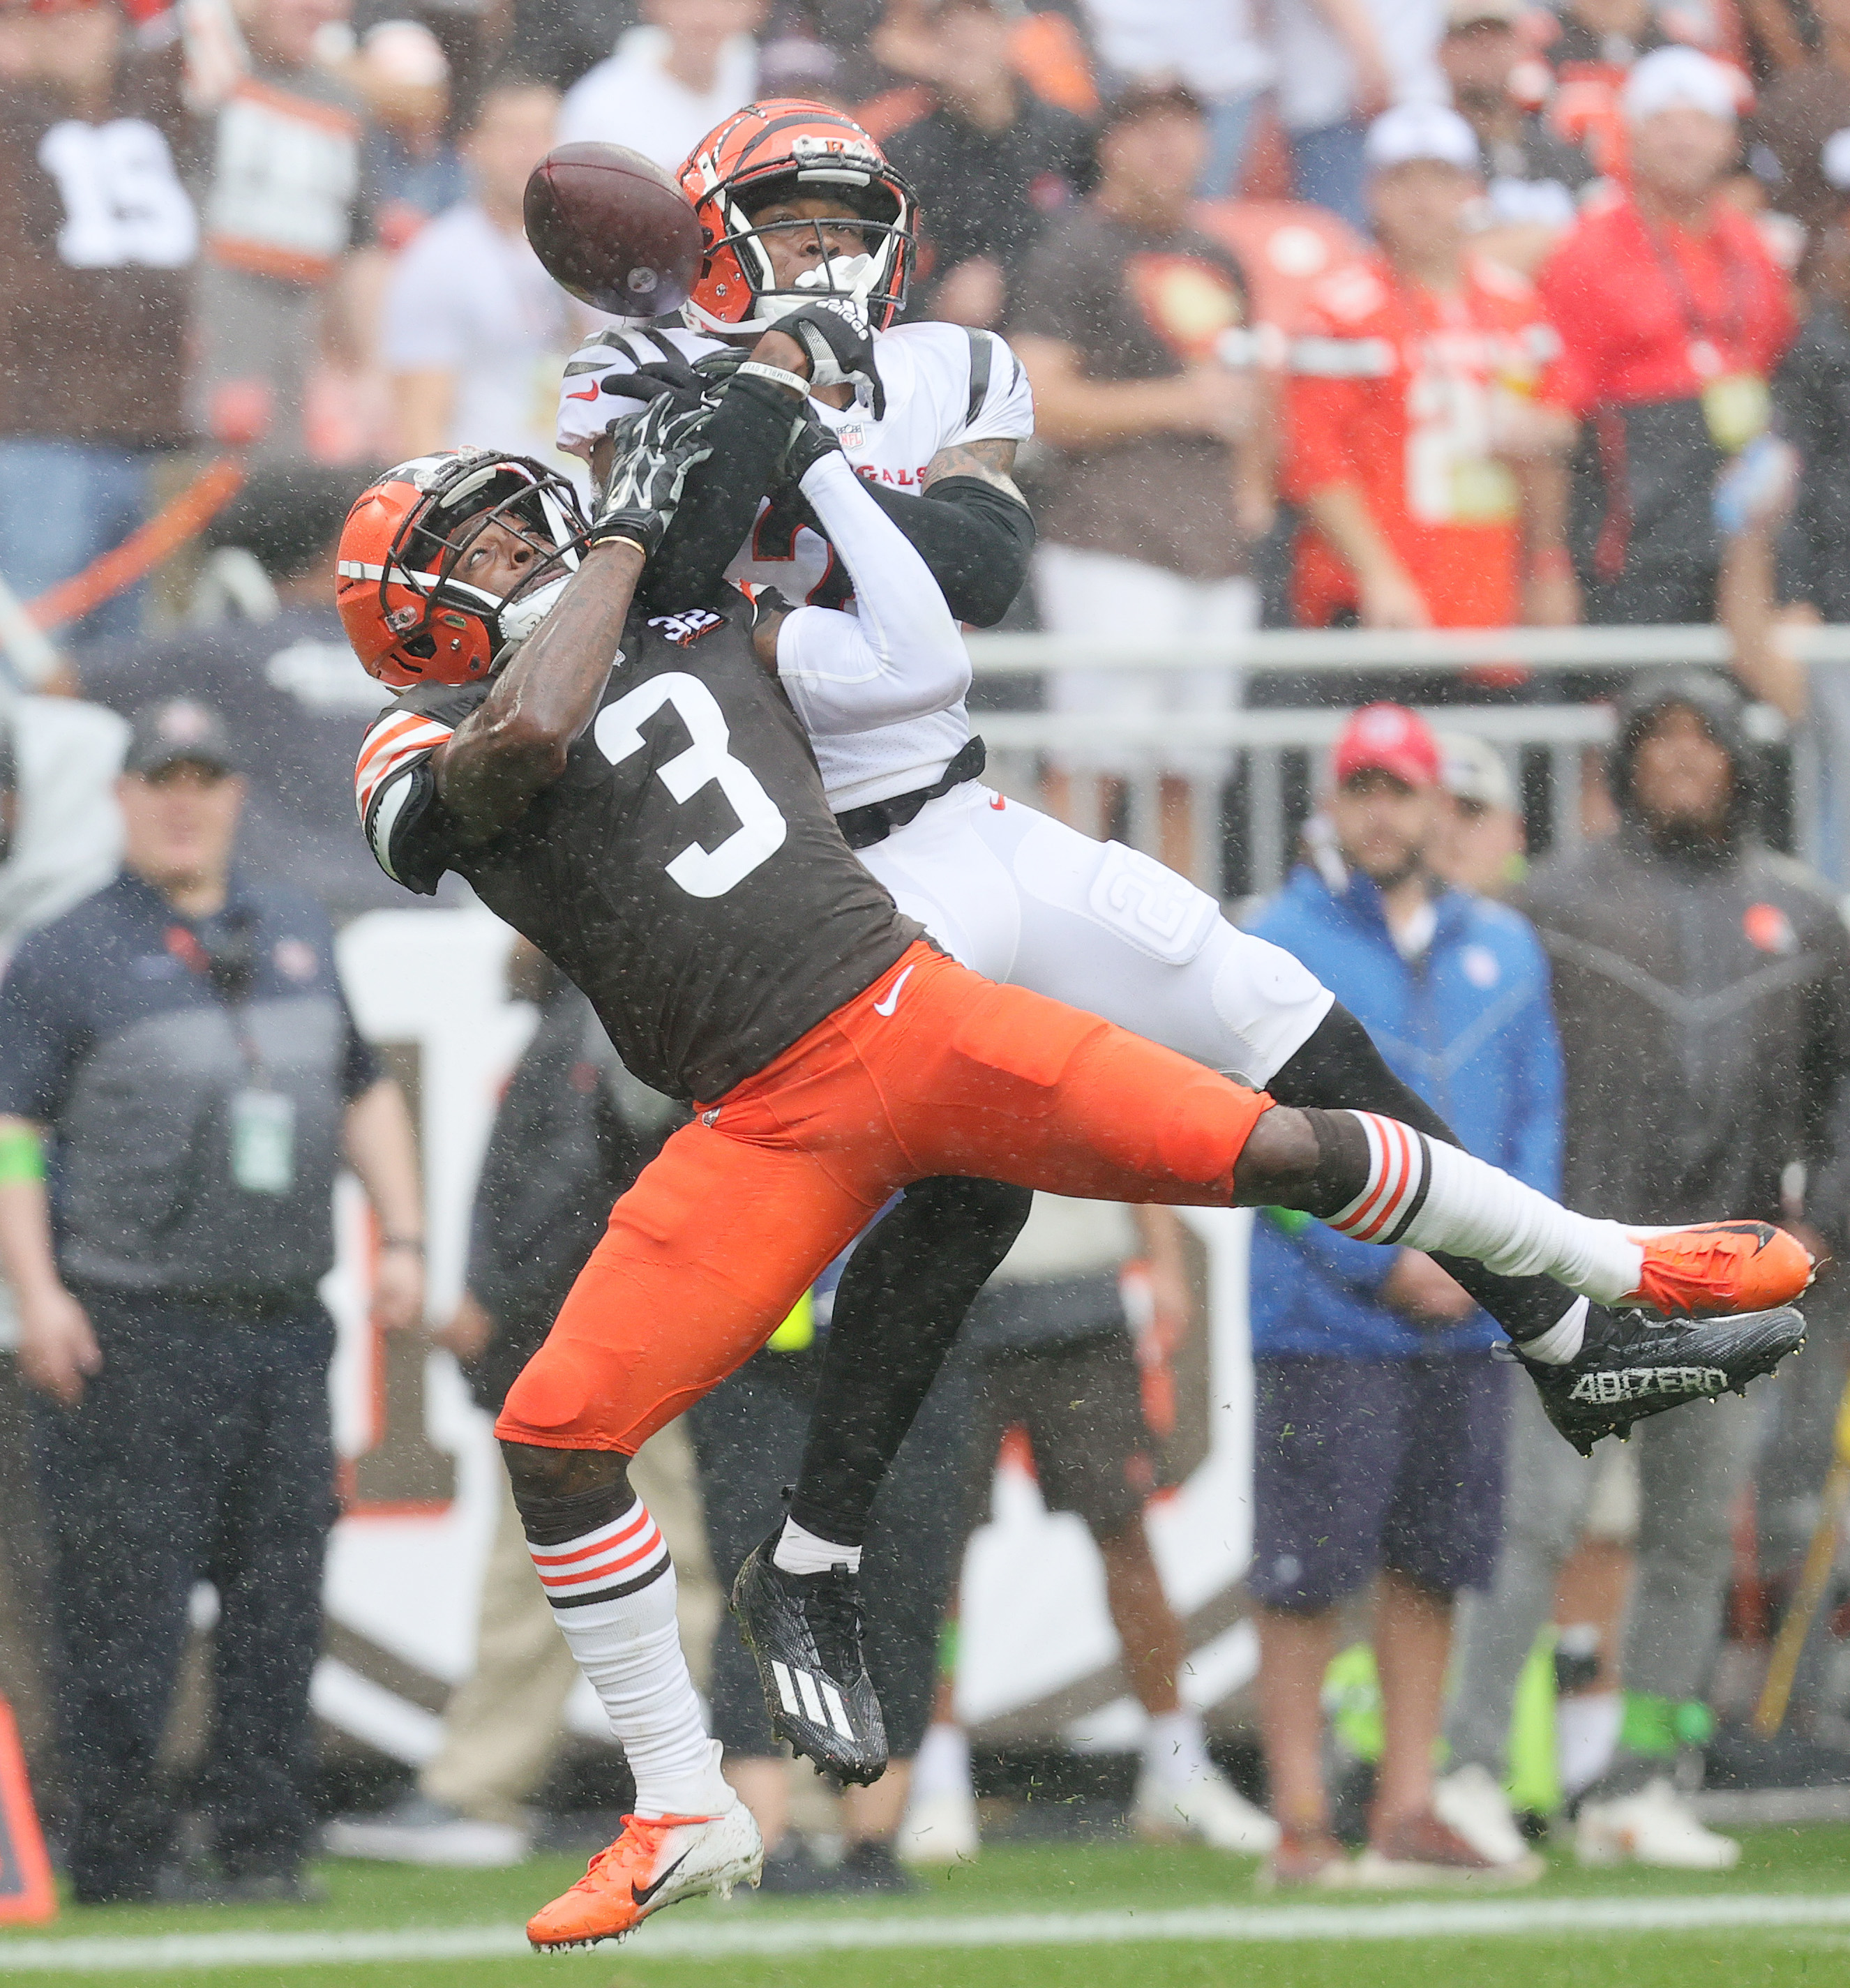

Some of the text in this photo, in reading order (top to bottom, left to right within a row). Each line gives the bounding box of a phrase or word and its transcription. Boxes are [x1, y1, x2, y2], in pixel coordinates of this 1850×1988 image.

[39, 117, 200, 268] 15
[815, 300, 869, 340] adidas
[762, 366, 795, 383] HUMBLE
[841, 432, 862, 446] NFL
[856, 465, 928, 485] GALS
[647, 608, 721, 642] 32
[594, 671, 788, 898] 3
